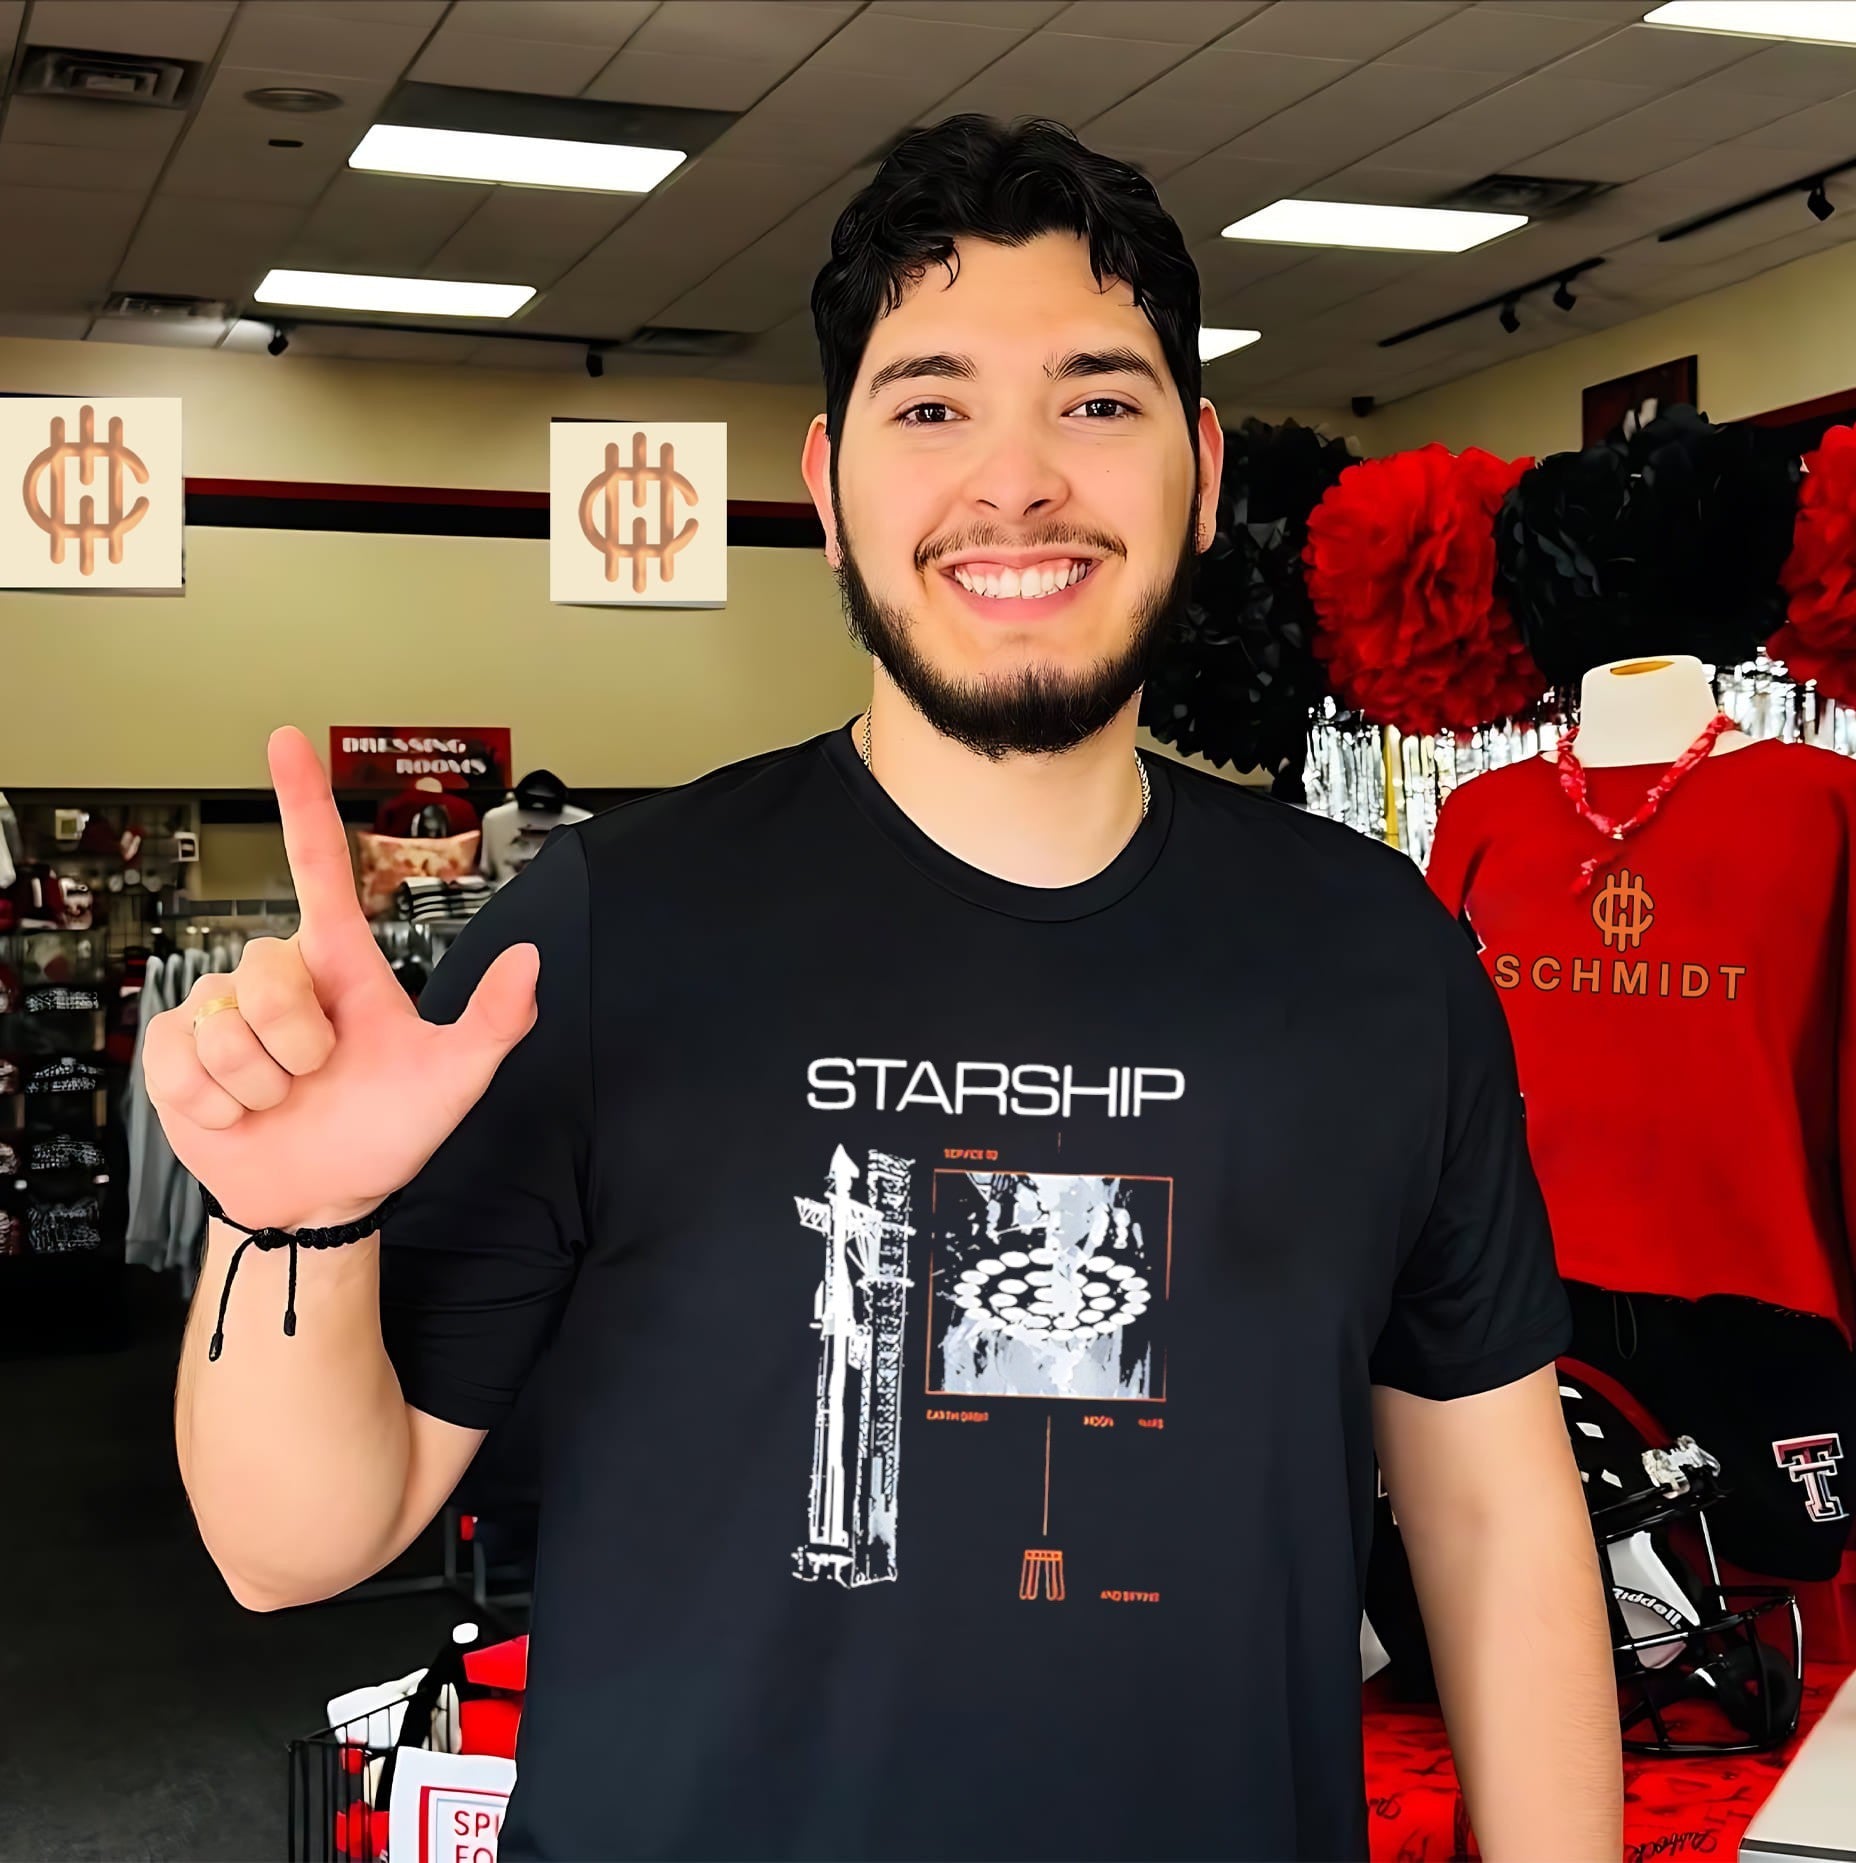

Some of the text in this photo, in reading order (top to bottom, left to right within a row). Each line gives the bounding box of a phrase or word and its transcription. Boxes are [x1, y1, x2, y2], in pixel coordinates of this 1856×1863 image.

[342, 737, 467, 753] DRESSING
[396, 759, 487, 774] ROOMS
[1494, 953, 1747, 1000] SCHMIDT
[806, 1057, 1186, 1118] STARSHIP
